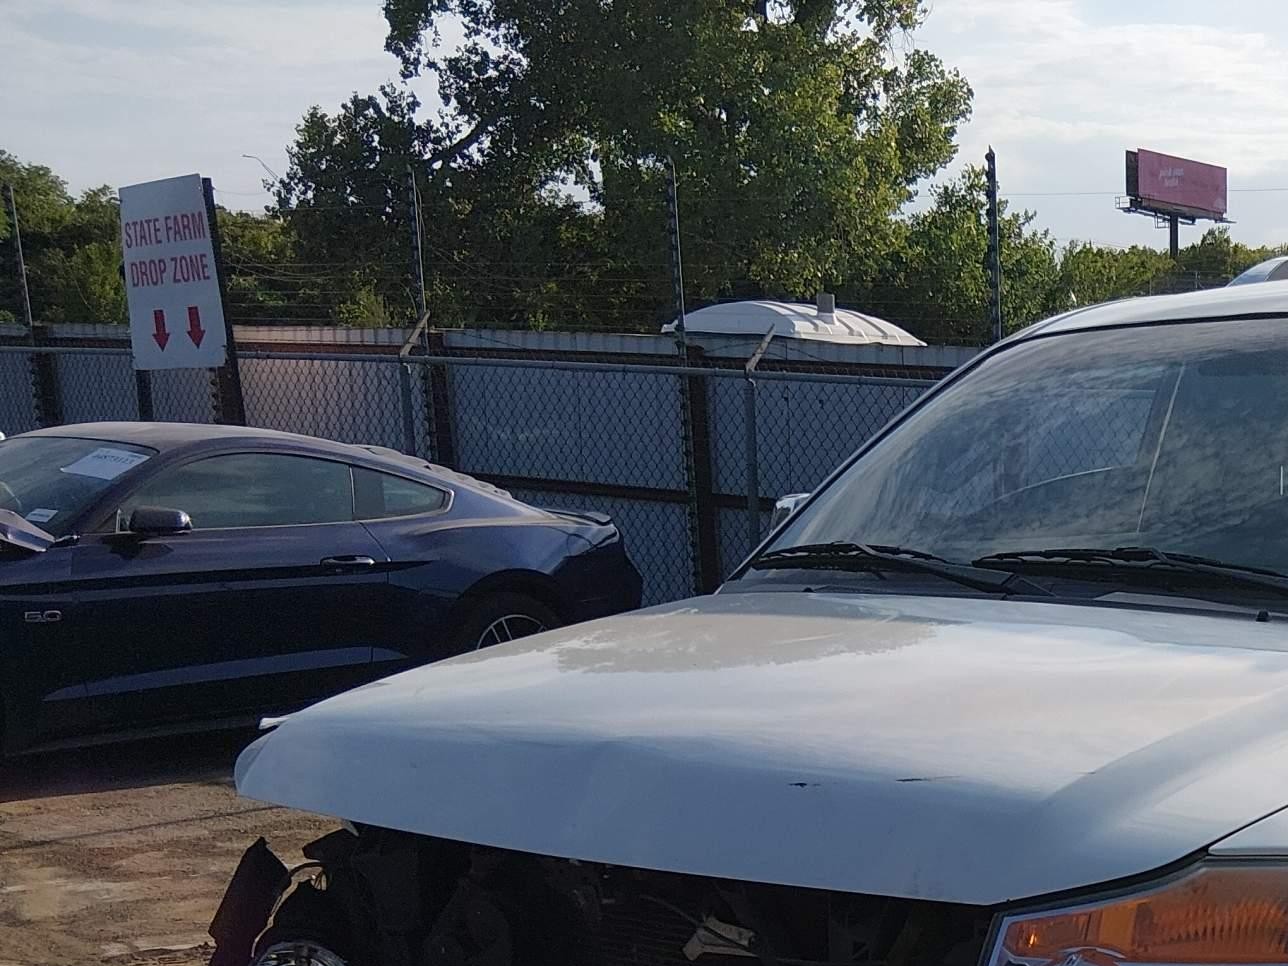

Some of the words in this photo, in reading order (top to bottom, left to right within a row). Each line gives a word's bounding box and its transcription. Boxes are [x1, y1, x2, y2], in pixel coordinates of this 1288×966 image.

[125, 218, 162, 248] STATE
[164, 211, 206, 243] FARM
[131, 258, 167, 287] DROP
[170, 253, 210, 284] ZONE
